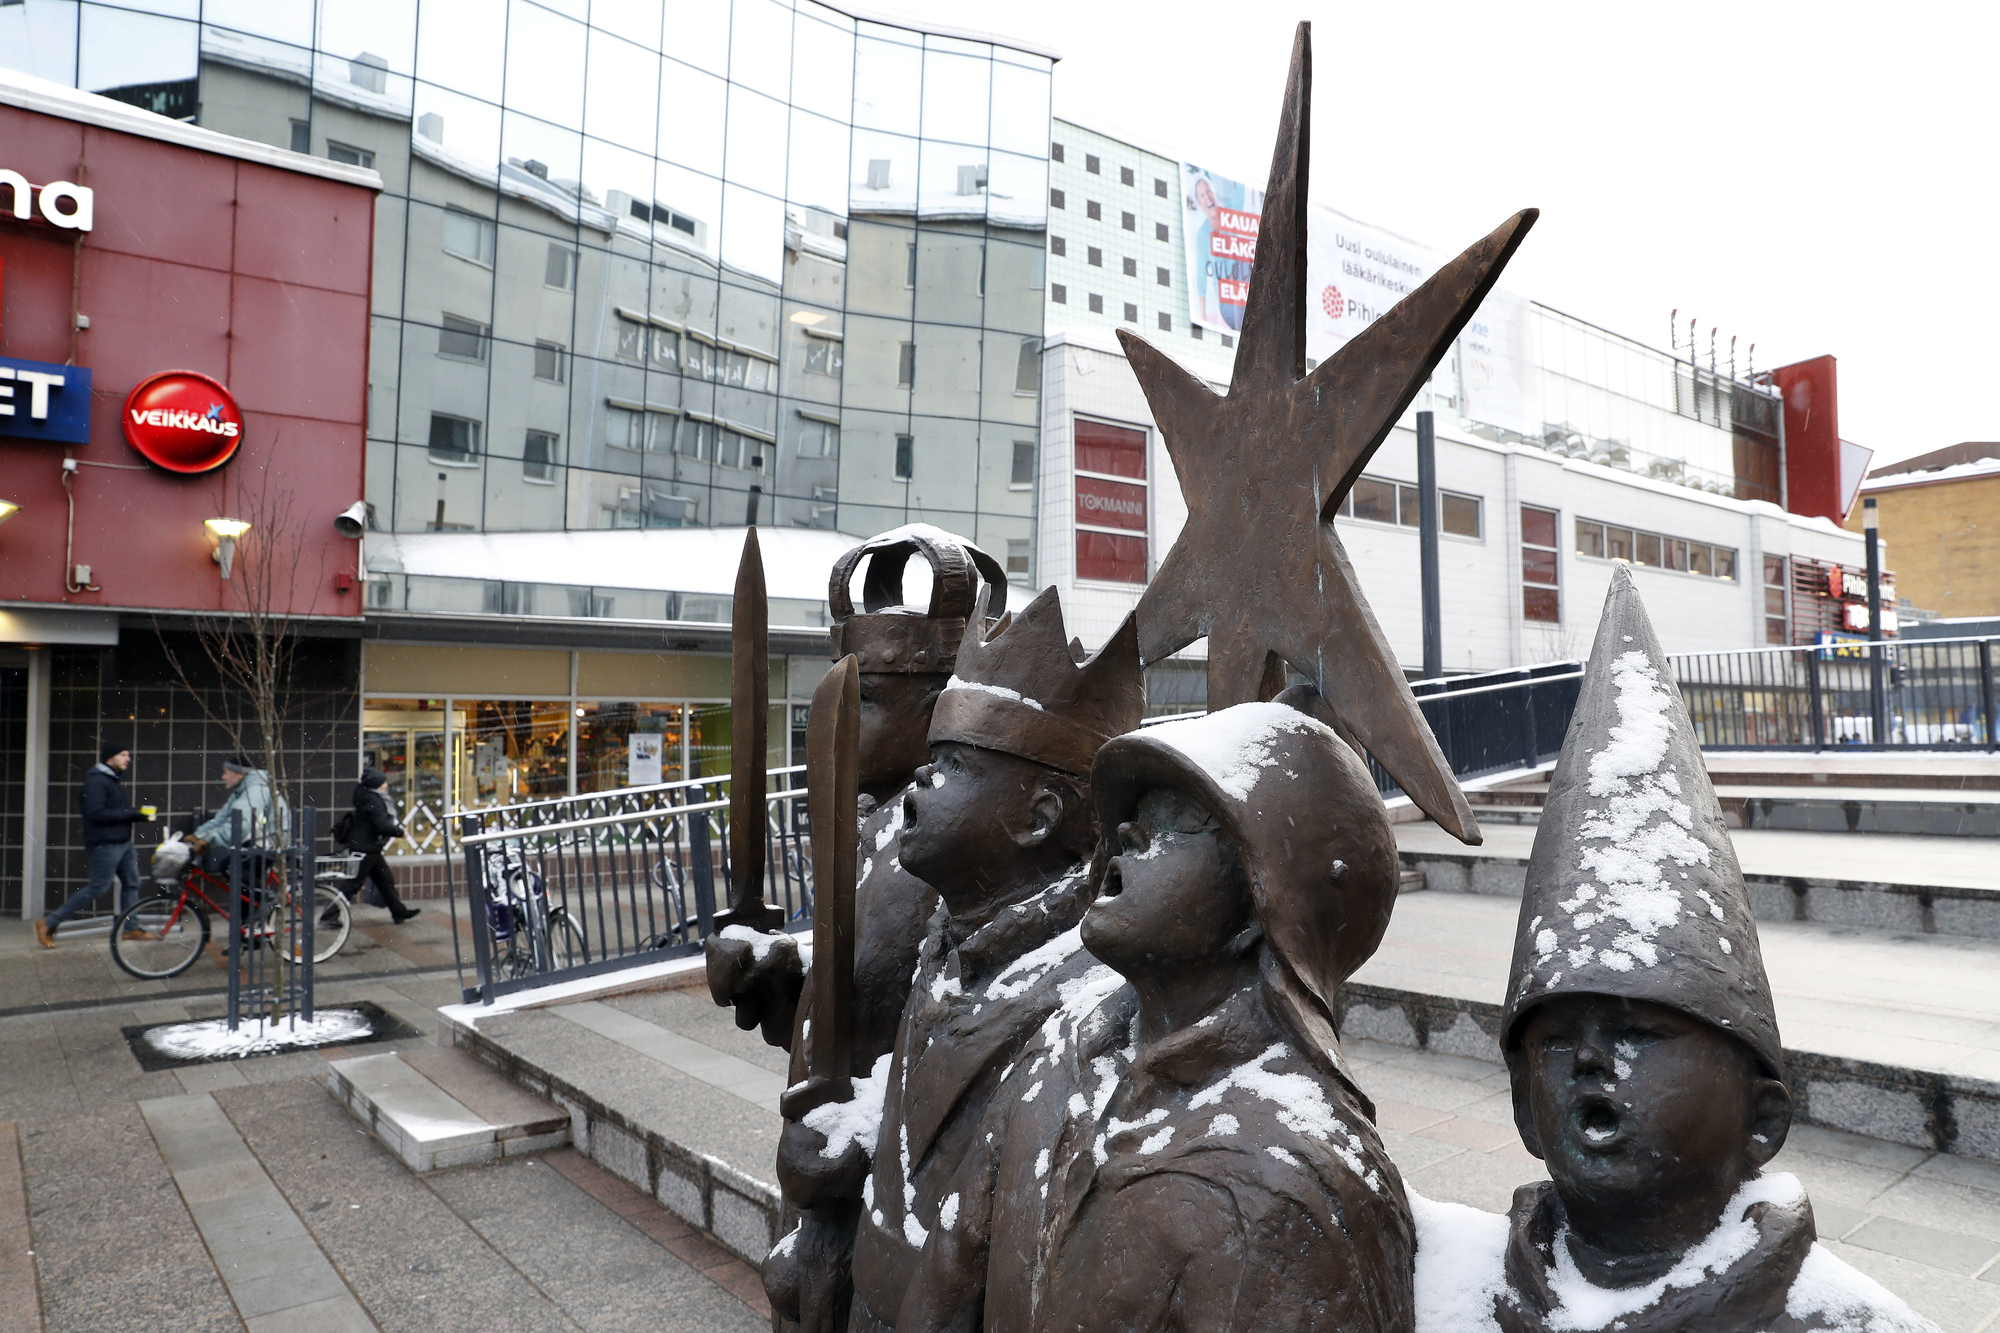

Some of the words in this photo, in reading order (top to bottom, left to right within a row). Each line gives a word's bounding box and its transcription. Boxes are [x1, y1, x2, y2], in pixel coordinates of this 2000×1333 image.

[0, 168, 94, 232] na
[1220, 212, 1259, 233] KAUA
[1212, 236, 1257, 259] ELÄKÖ
[1335, 233, 1361, 255] Uusi
[1364, 247, 1422, 277] oululainen
[1206, 259, 1253, 281] OULUL
[1342, 259, 1415, 295] lääkärikesku
[1220, 281, 1248, 302] ELÄ
[1347, 298, 1384, 323] Pihl
[131, 409, 239, 437] VEIKKAUS
[1077, 493, 1143, 516] TOKMANNI
